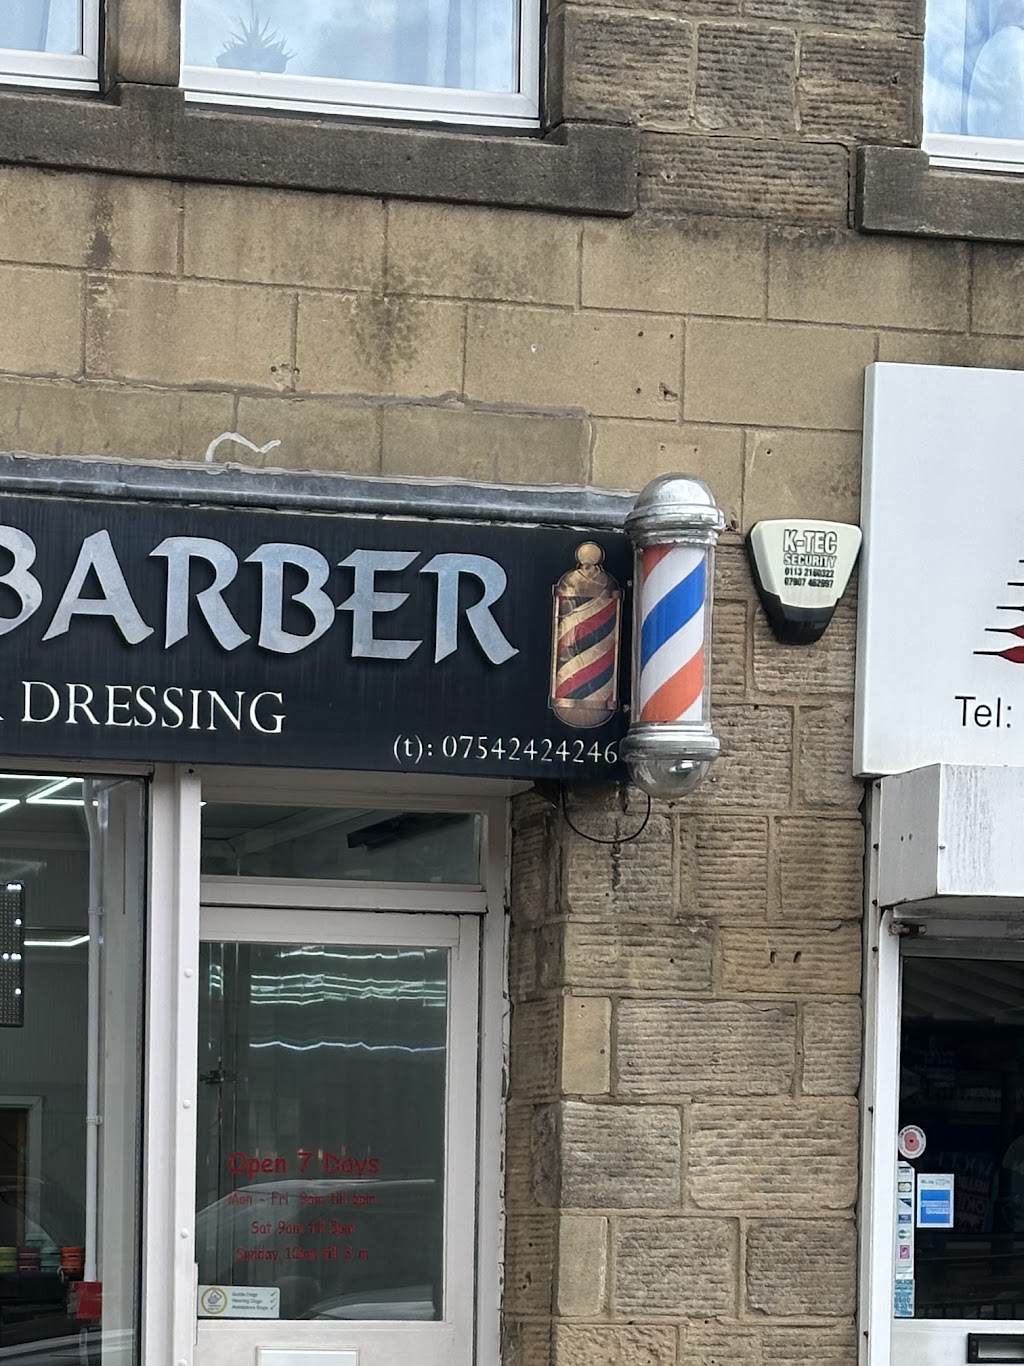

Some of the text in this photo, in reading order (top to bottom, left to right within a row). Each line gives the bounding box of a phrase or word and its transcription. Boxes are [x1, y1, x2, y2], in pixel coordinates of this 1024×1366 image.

[783, 529, 837, 554] K-TEC
[783, 553, 837, 567] SECURITY
[784, 567, 803, 577] 0113
[22, 680, 286, 734] DRESSING
[955, 695, 1012, 728] Tel:
[393, 734, 618, 764] (t): 07542424246
[228, 1152, 381, 1179] Open 7 Days
[227, 1191, 252, 1206] Mon
[271, 1191, 289, 1206] Fri
[330, 1191, 346, 1206] till
[250, 1221, 272, 1235] Sat
[278, 1221, 304, 1235] 9am
[308, 1221, 325, 1235] till
[236, 1246, 279, 1264] Sunday
[322, 1246, 338, 1261] till
